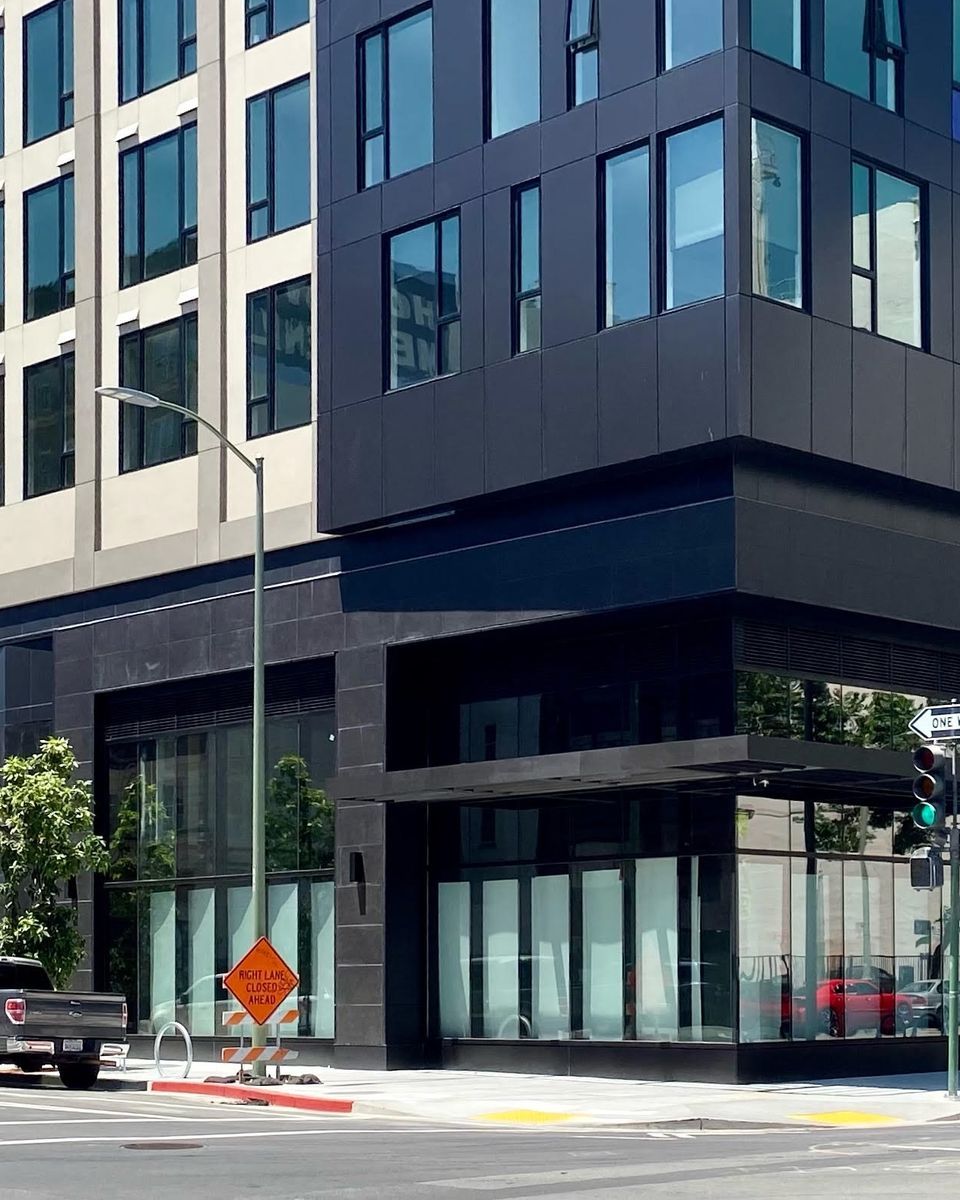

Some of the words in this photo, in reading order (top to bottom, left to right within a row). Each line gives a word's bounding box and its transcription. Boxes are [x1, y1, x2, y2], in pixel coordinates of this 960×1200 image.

[932, 717, 953, 729] ONE
[239, 970, 262, 980] RIGHT
[265, 970, 285, 980] LANE
[246, 983, 277, 993] CLOSED
[248, 995, 276, 1005] AHEAD
